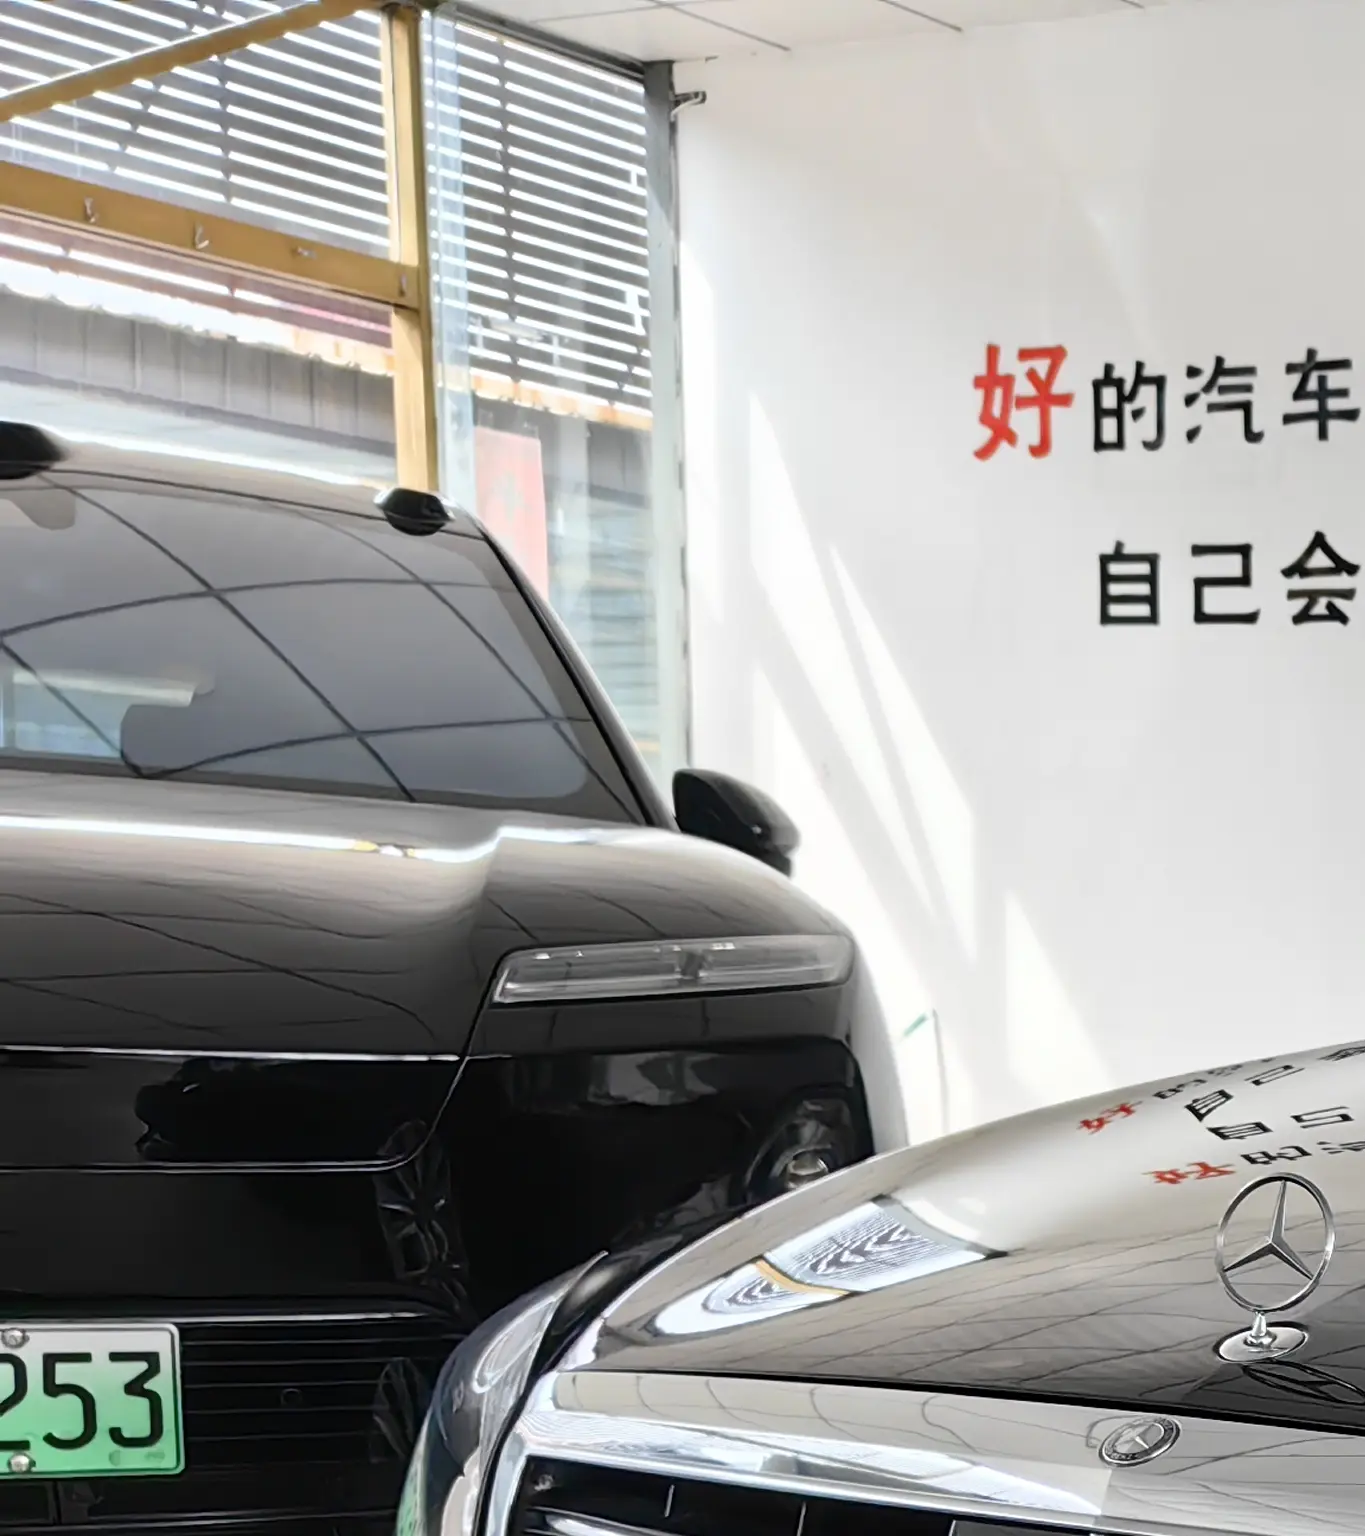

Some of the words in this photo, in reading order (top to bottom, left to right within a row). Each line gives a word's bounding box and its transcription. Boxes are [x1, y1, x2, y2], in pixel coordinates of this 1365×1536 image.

[973, 343, 1362, 461] 好的汽车
[0, 1352, 163, 1450] 253
